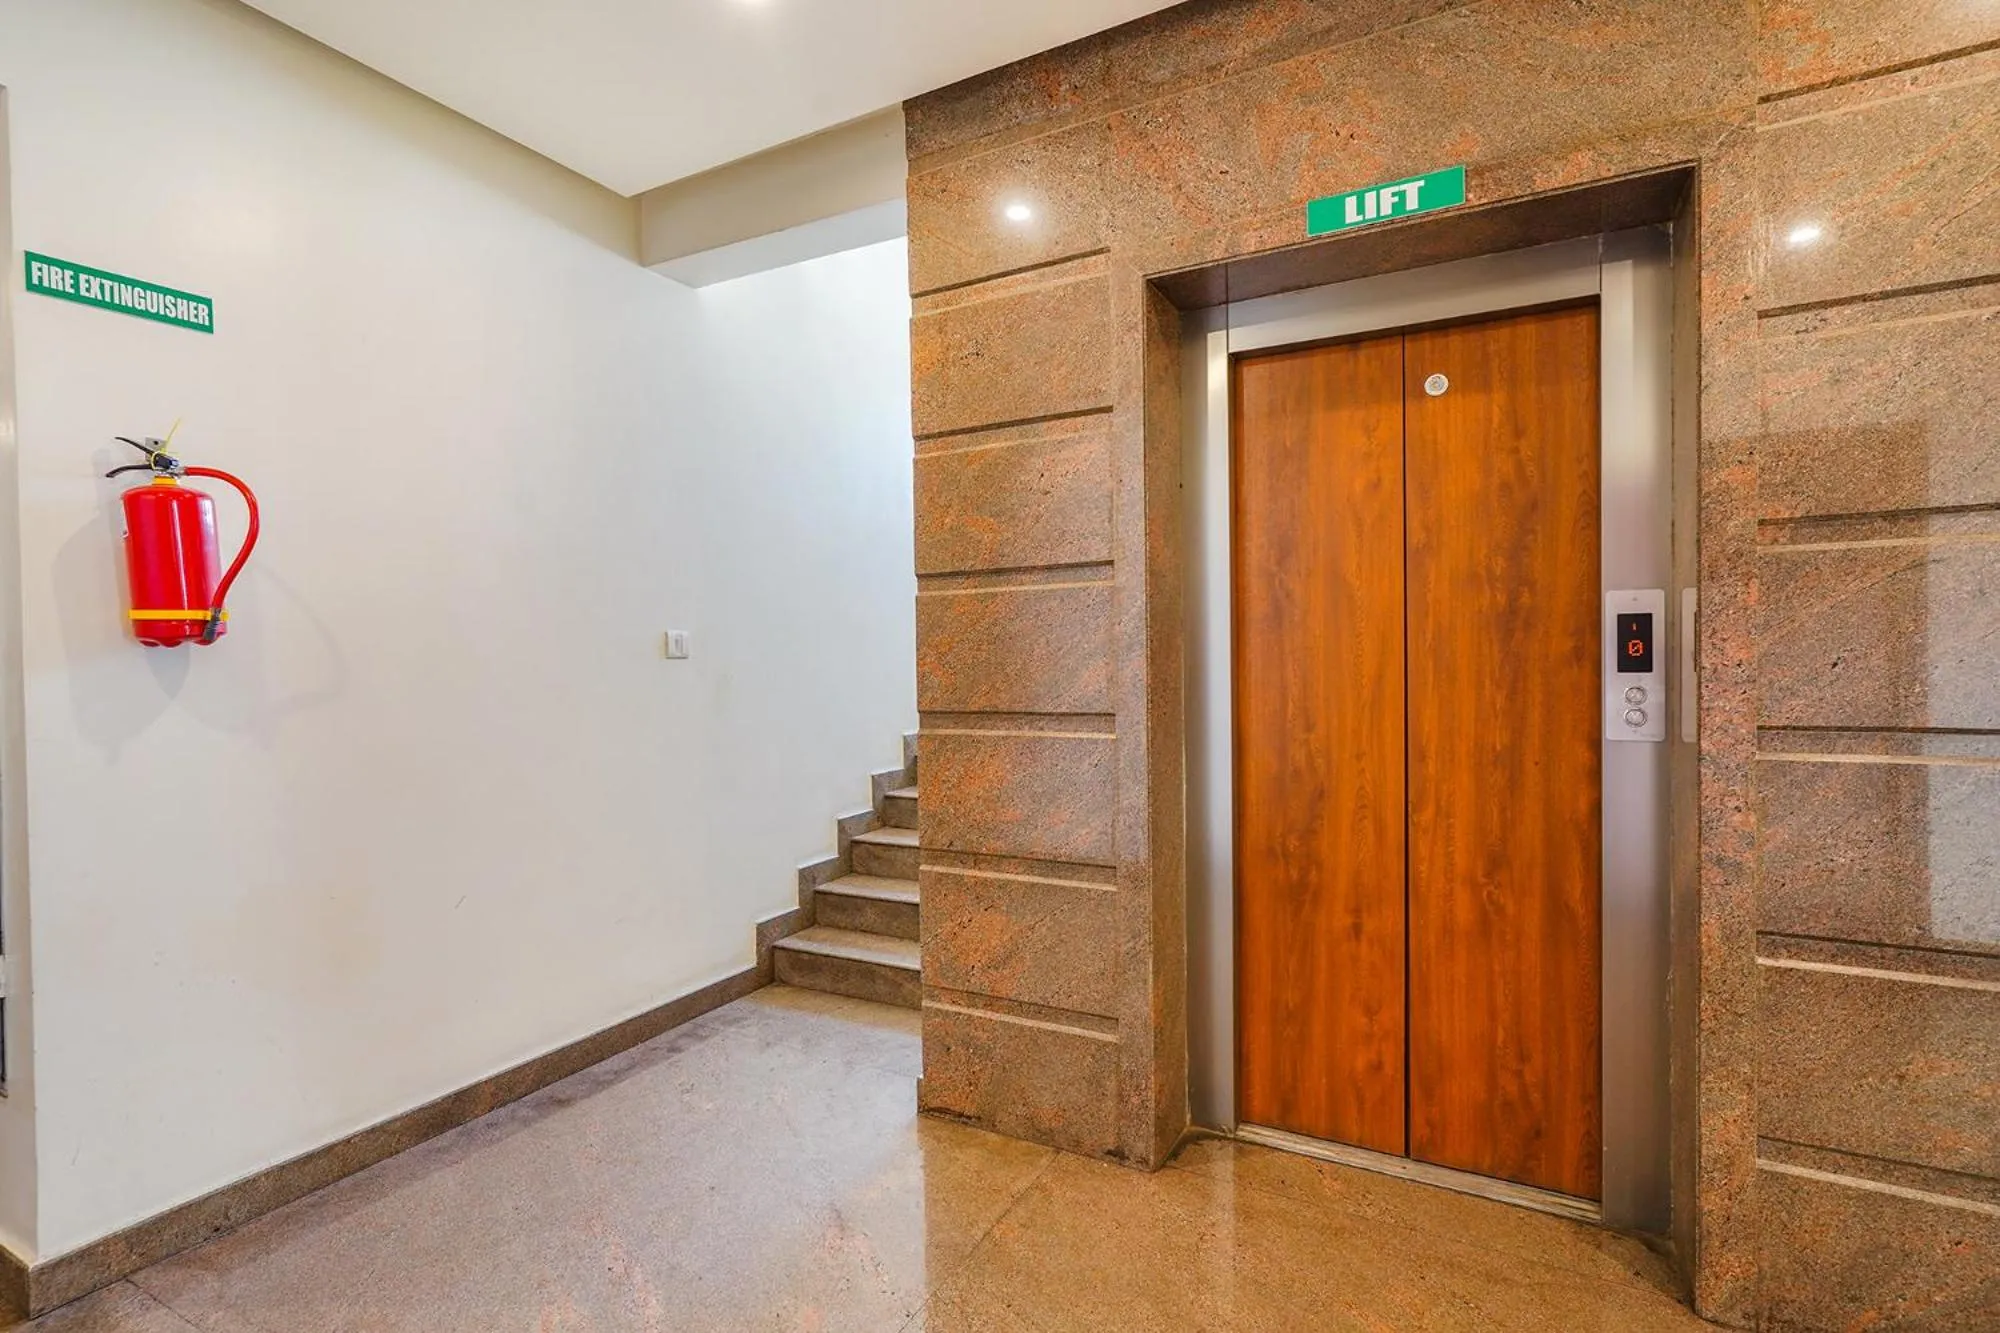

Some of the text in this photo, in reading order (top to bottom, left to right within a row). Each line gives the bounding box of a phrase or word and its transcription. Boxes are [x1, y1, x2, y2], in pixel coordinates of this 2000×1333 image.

[1345, 180, 1425, 224] LIFT
[31, 261, 209, 325] FIRE EXTINGUISHER
